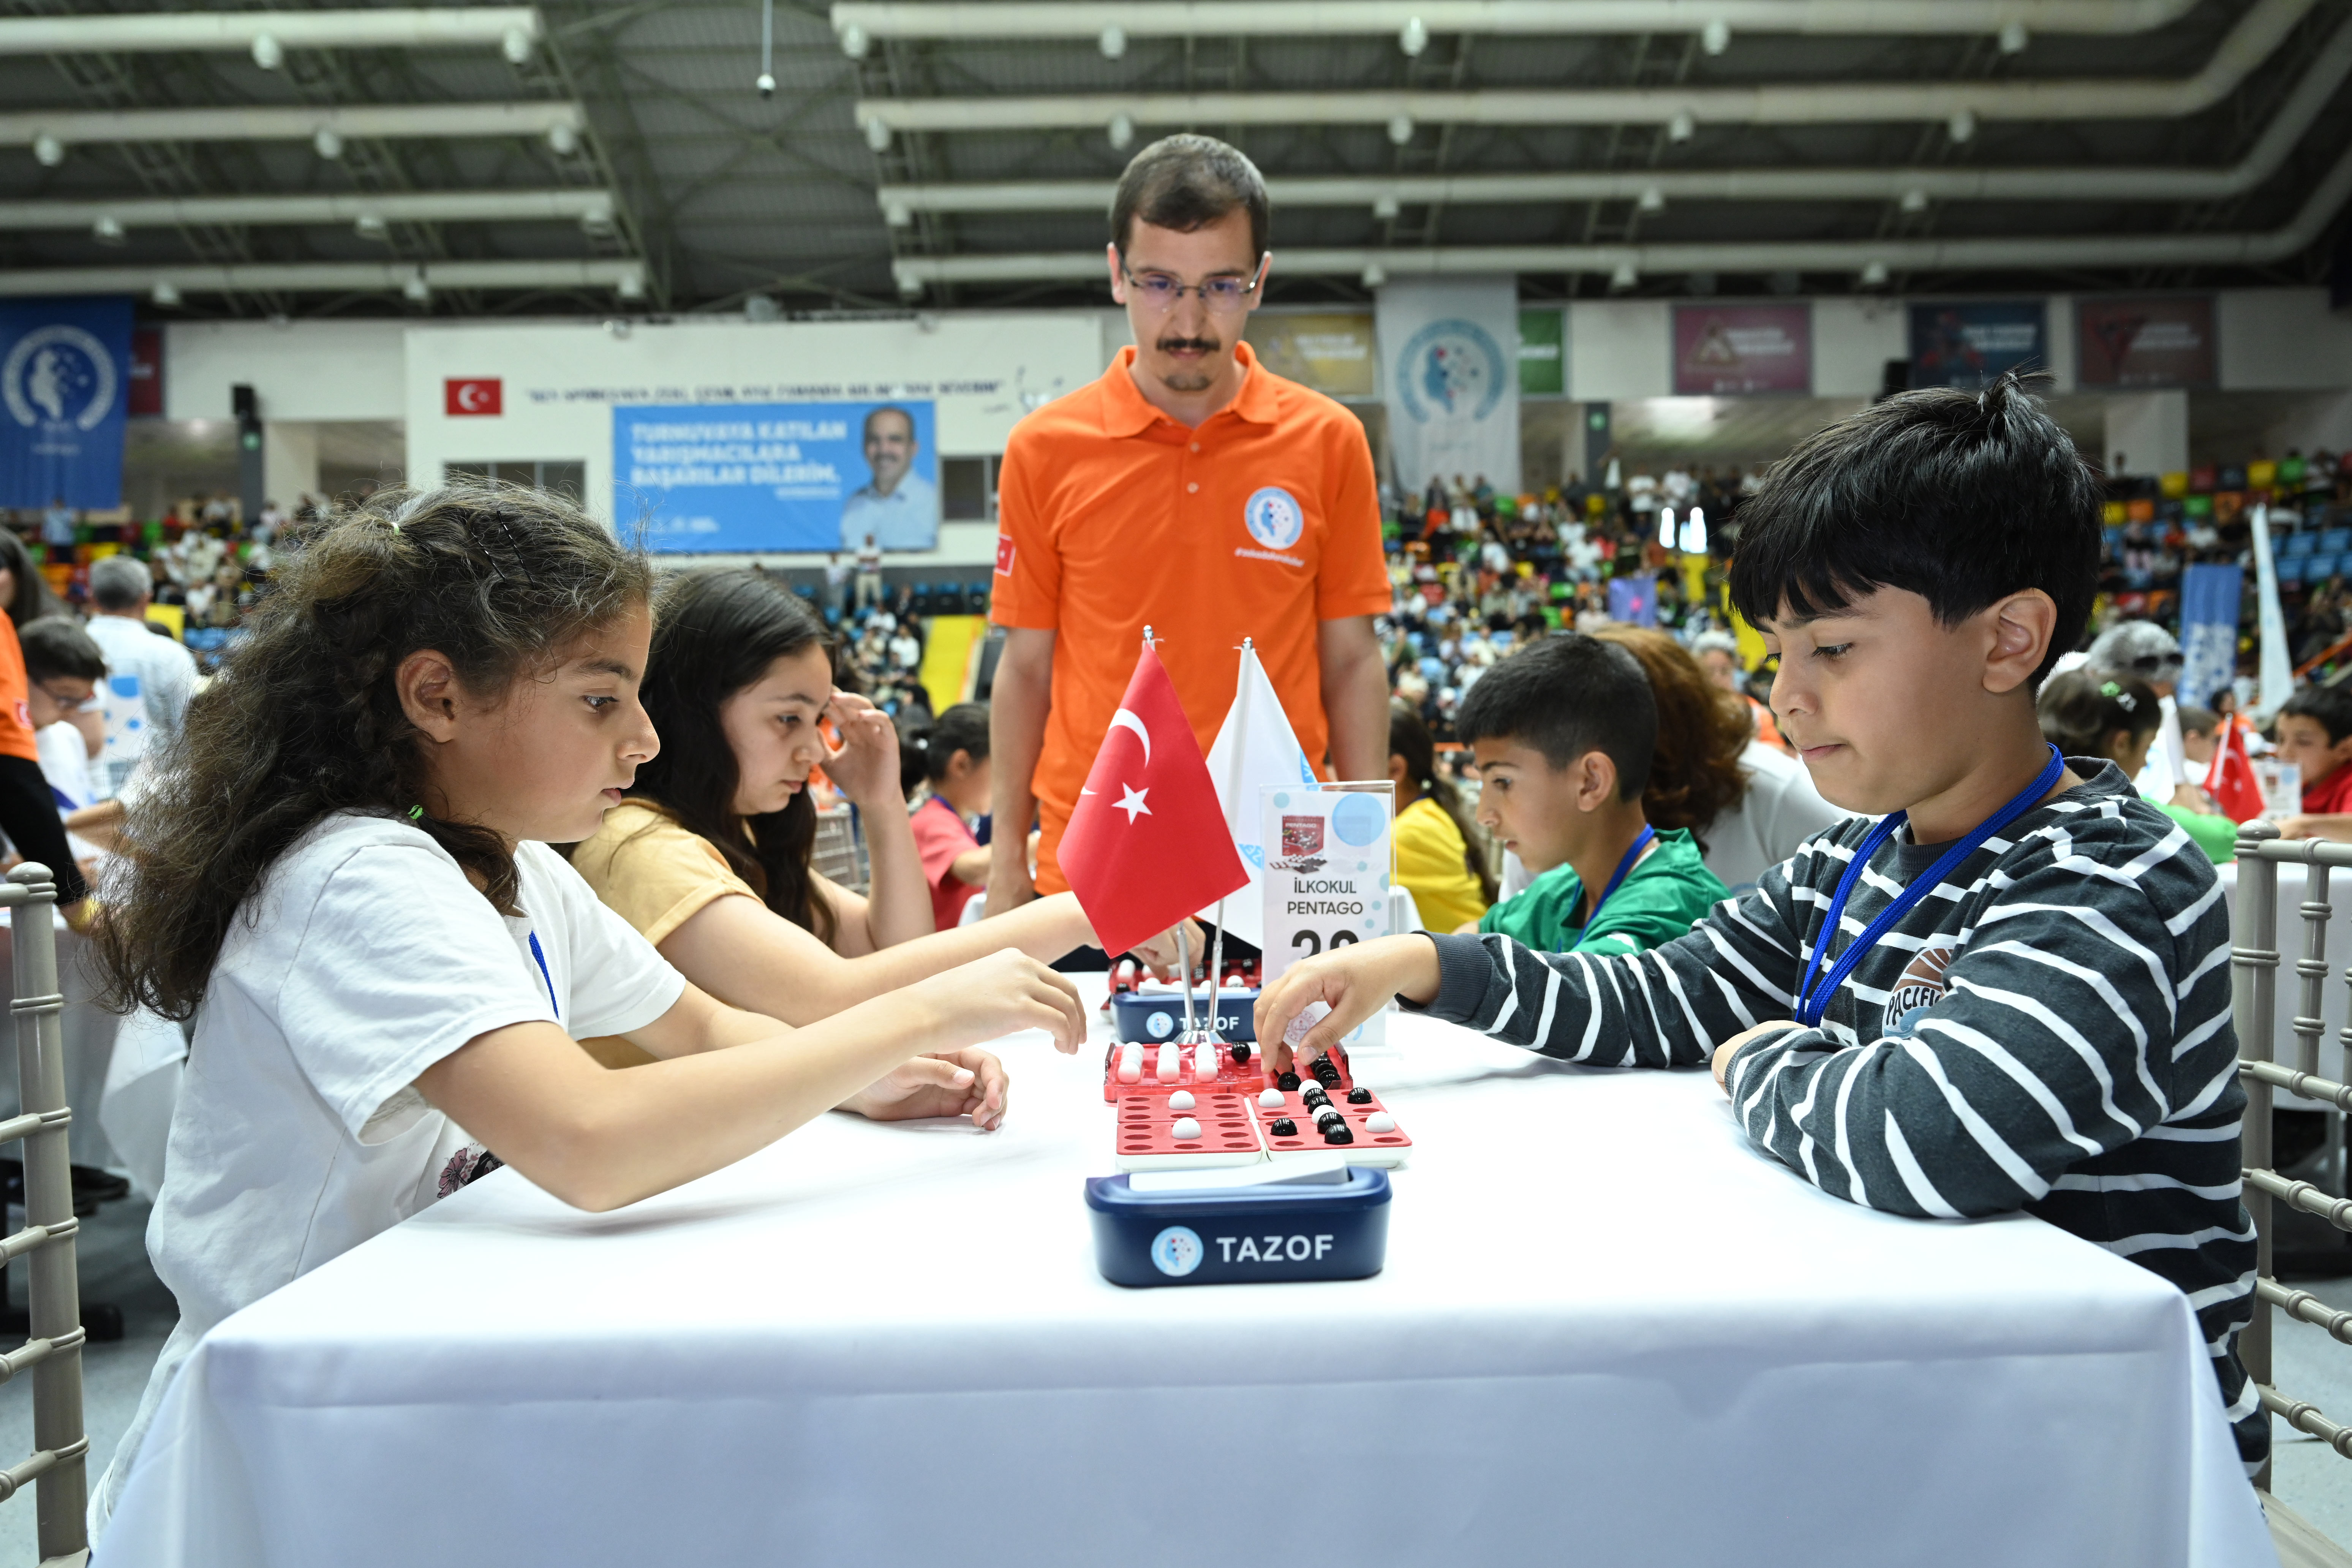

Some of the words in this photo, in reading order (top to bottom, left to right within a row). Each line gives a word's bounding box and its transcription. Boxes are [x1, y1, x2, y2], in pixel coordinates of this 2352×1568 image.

[759, 421, 847, 439] KATILAN
[1294, 877, 1357, 893] İLKOKUL
[1287, 901, 1363, 914] PENTAGO
[1216, 1234, 1334, 1263] TAZOF
